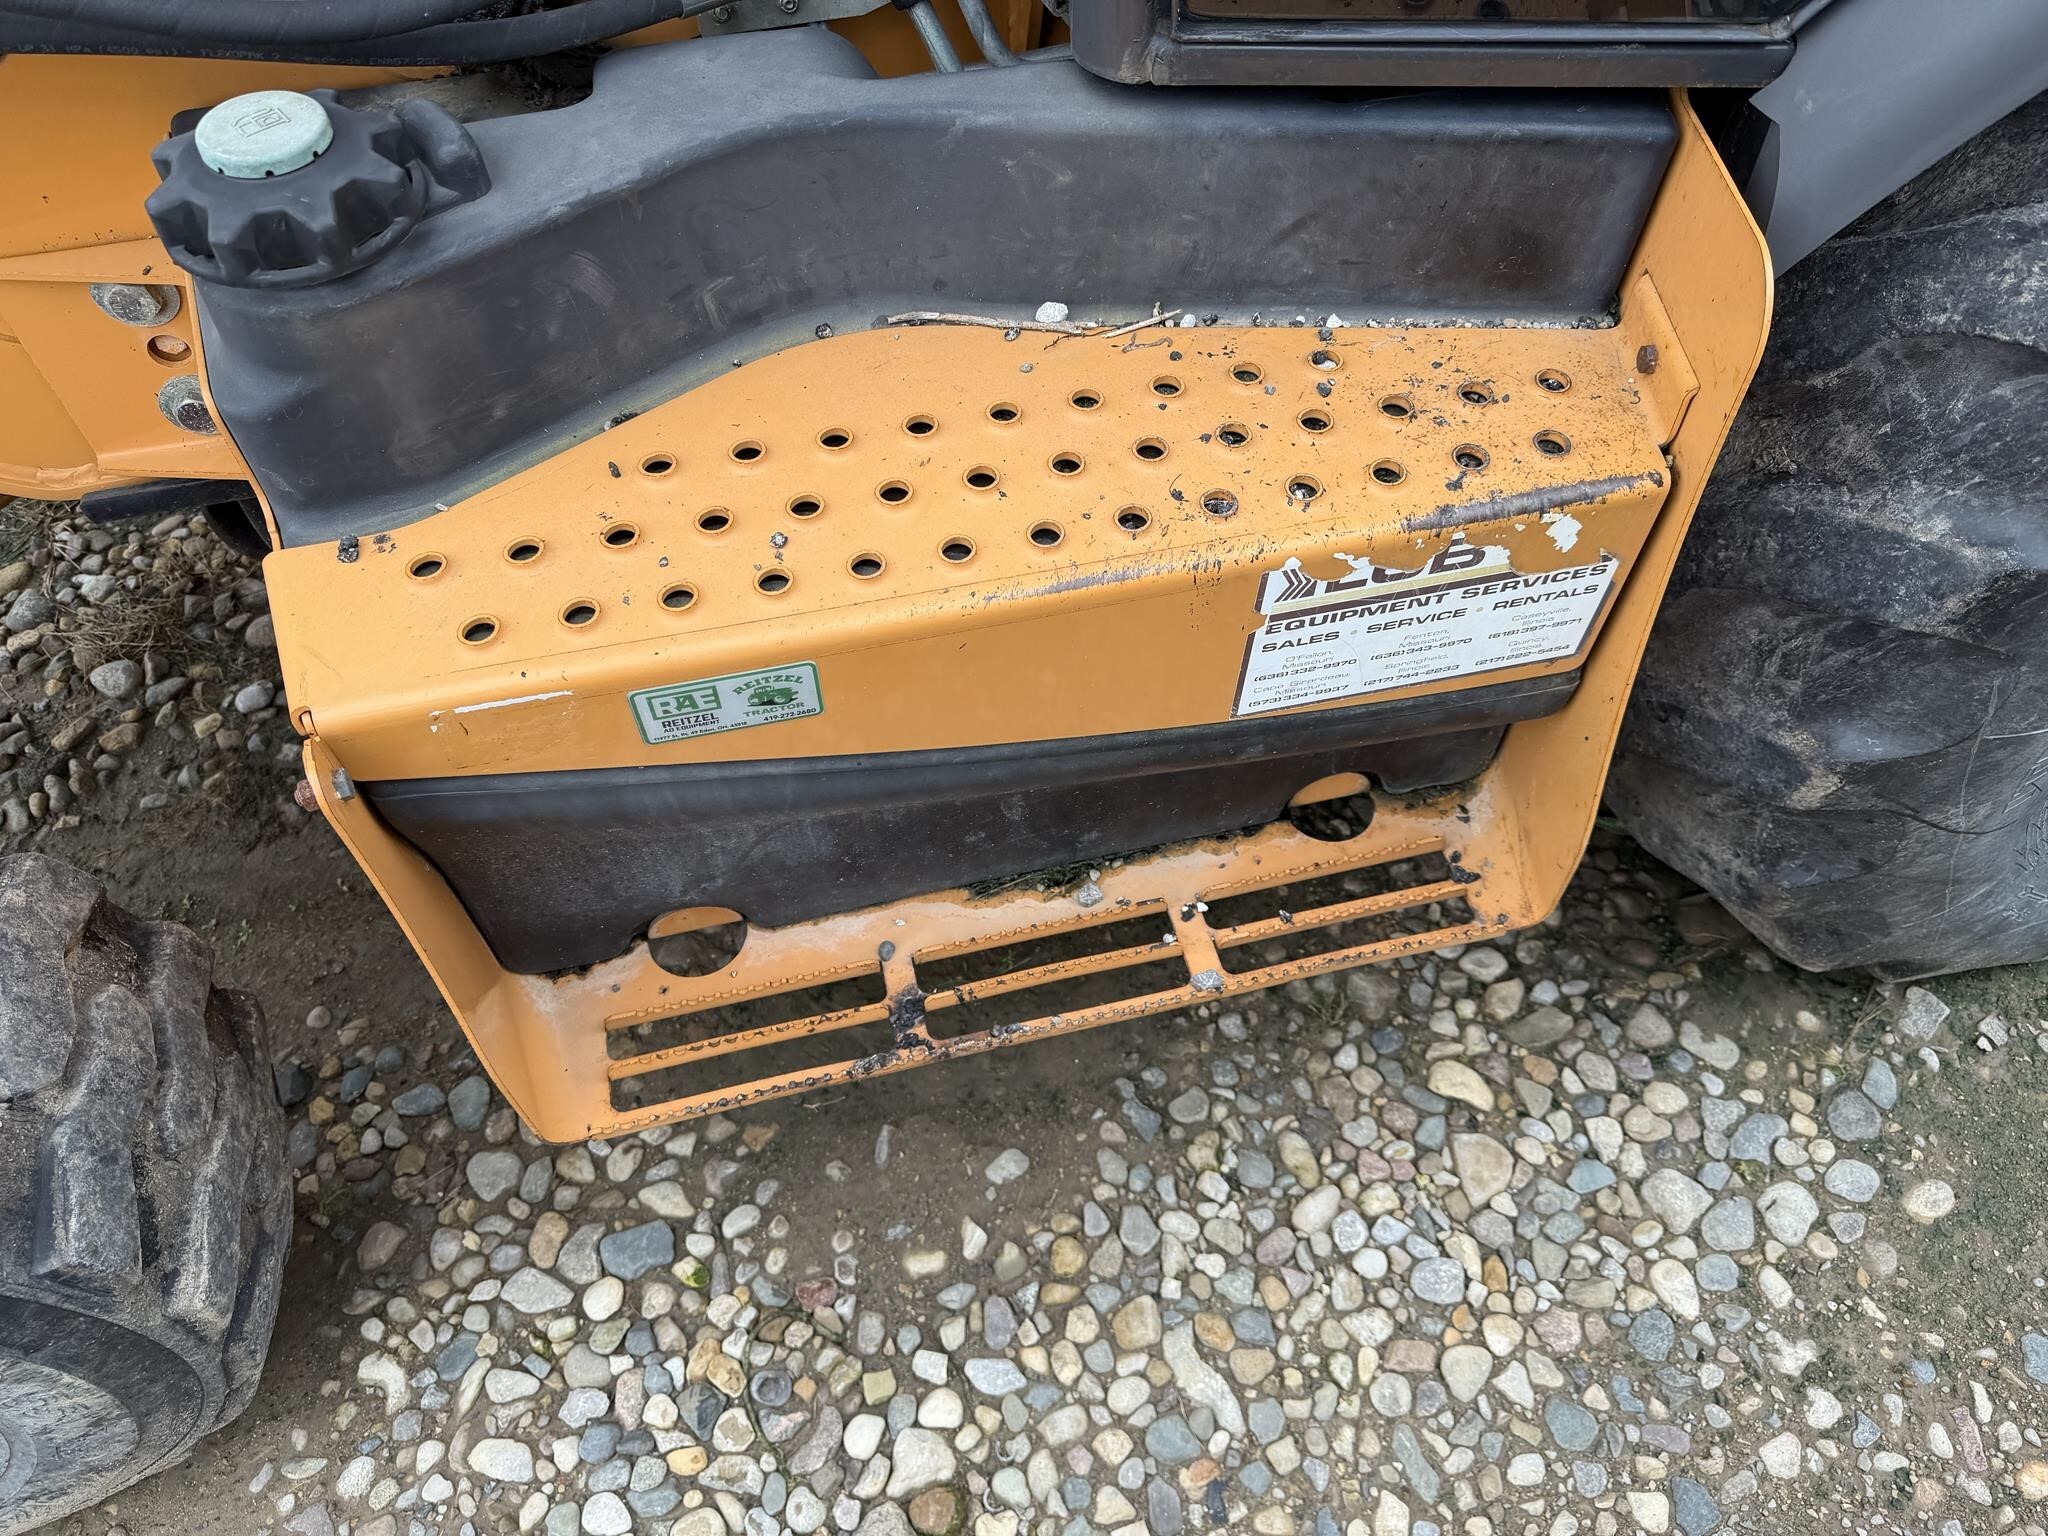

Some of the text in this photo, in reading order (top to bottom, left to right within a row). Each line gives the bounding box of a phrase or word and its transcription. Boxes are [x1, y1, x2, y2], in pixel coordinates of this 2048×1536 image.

[1265, 564, 1609, 635] EQUIPMENT SERVICES
[1261, 584, 1600, 653] SALES SERVICE RENTALS
[1398, 635, 1451, 649] Missouri
[1404, 629, 1450, 641] Fenton,
[1281, 656, 1334, 671] Missouri
[732, 675, 804, 695] REITZEL
[1253, 682, 1284, 697] Cape
[1275, 682, 1327, 696] Missouri
[743, 702, 805, 717] TRACTOR
[661, 712, 720, 729] REITZEL
[676, 719, 720, 732] EQUIPMENT
